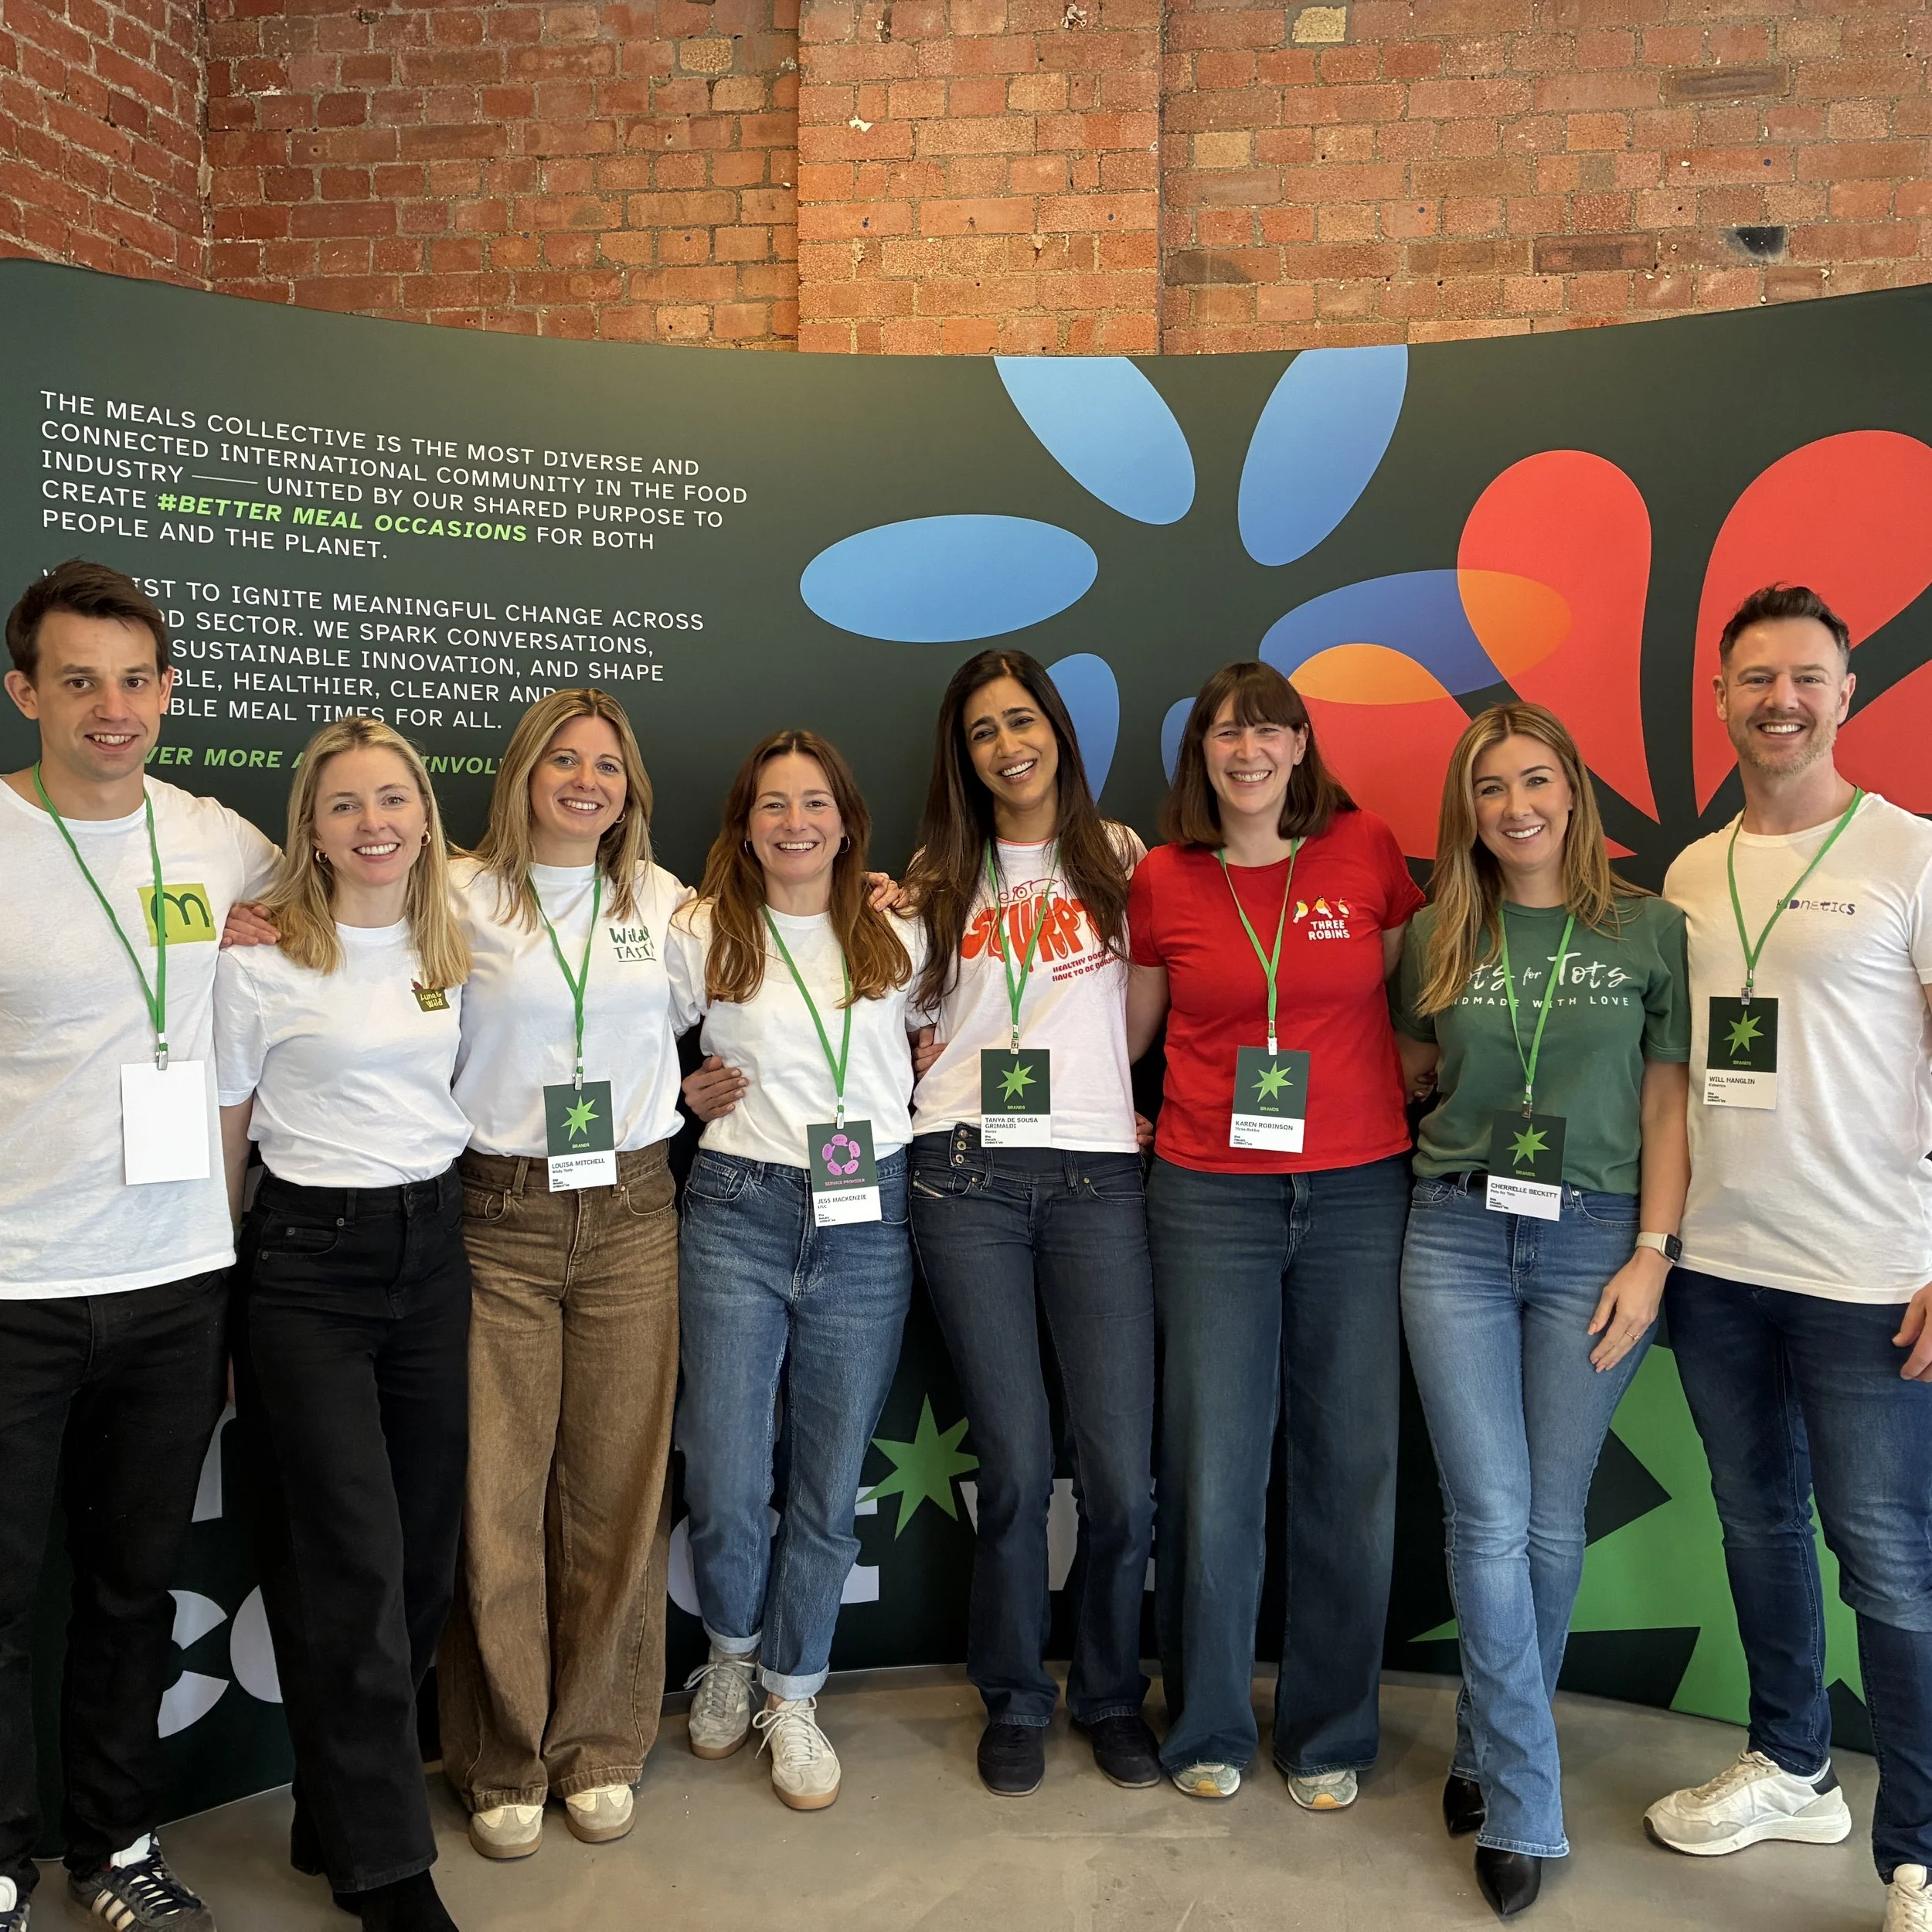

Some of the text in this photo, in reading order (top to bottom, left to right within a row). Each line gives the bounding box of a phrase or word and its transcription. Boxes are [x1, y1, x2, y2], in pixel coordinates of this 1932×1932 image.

[40, 390, 699, 475] THE MEALS COLLECTIVE IS THE MOST DIVERSE AND
[42, 420, 747, 503] CONNECTED INTERNATIONAL COMMUNITY IN THE FOOD
[43, 450, 723, 527] INDUSTRY UNITED BY OUR SHARED PURPOSE TO
[43, 480, 653, 549] CREATE #BETTER MEAL OCCASIONS FOR BOTH
[43, 509, 387, 559] PEOPLE AND THE PLANET.
[186, 582, 219, 601] TO
[232, 586, 322, 609] IGNITE
[333, 594, 496, 620] MEANINGFUL
[505, 604, 603, 625] CHANGE
[612, 611, 703, 630] ACROSS
[196, 612, 303, 636] SECTOR.
[313, 620, 349, 639] WE
[360, 623, 437, 644] SPARK
[447, 628, 652, 658] CONVERSATIONS,
[172, 639, 663, 681] SUSTAINABLE INNOVATION, AND SHAPE
[234, 672, 379, 699] HEALTHIER,
[390, 680, 499, 701] CLEANER
[230, 701, 297, 720] MEAL
[307, 704, 385, 723] TIMES
[396, 709, 442, 726] FOR
[453, 711, 502, 729] ALL.
[204, 749, 283, 767] MORE
[1308, 930, 1351, 940] ROBINS
[1310, 920, 1345, 930] THREE
[613, 944, 654, 959] TAST
[1053, 957, 1086, 973] HEALTHY
[1052, 971, 1073, 981] HAVE
[1522, 967, 1543, 986] for
[1546, 952, 1632, 988] Tots
[1590, 995, 1629, 1006] LOVE
[552, 1161, 573, 1169] LOUISA
[832, 1194, 867, 1202] MACKENZIE
[1491, 1182, 1558, 1199] CHERRELLE BECKITT
